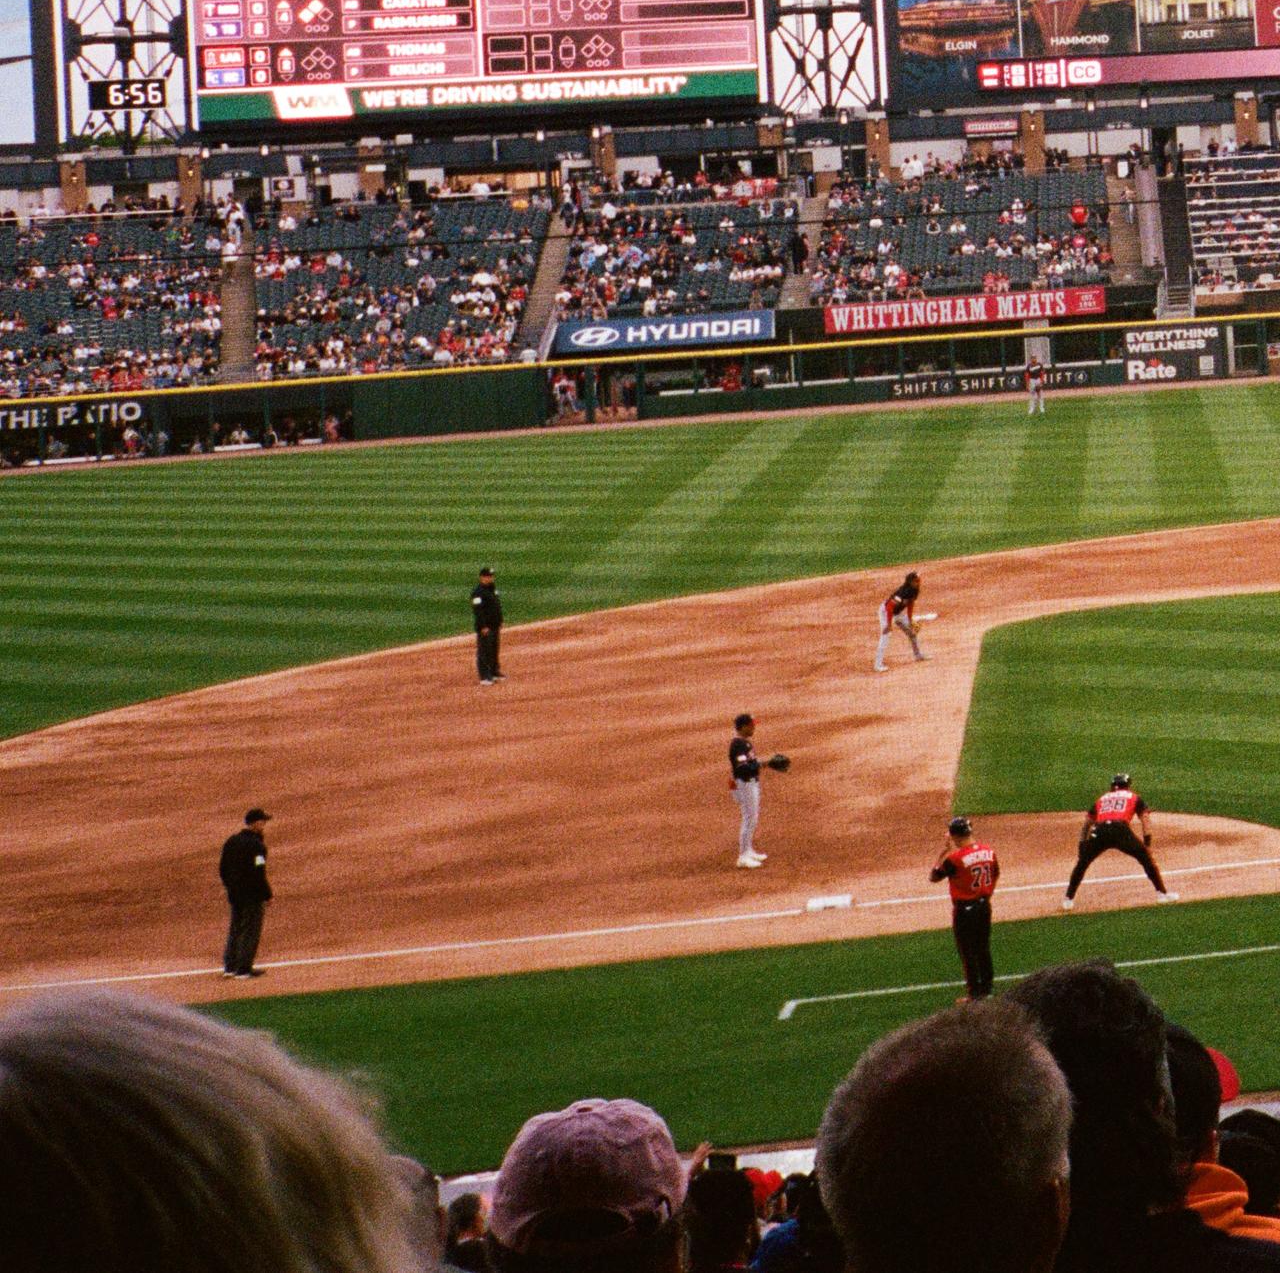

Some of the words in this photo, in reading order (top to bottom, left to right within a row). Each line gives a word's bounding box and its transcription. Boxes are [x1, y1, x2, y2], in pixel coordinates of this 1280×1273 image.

[1050, 34, 1110, 47] HAMMOND
[1180, 29, 1216, 41] JOLIET
[386, 43, 447, 57] THOMAS
[944, 40, 978, 52] ELGIN
[388, 61, 447, 77] KIKUCHI
[1073, 65, 1096, 79] CC
[108, 81, 163, 107] 6:56
[361, 88, 429, 109] WE'RE
[432, 83, 518, 106] DRIVING
[830, 297, 988, 333] WHITTINGHAM
[996, 290, 1069, 322] MEATS
[626, 316, 762, 345] HYUNDAI
[1125, 328, 1219, 342] EVERYTHING
[1125, 338, 1207, 353] WELLNESS
[1127, 359, 1177, 382] Rate
[971, 864, 992, 888] 71
